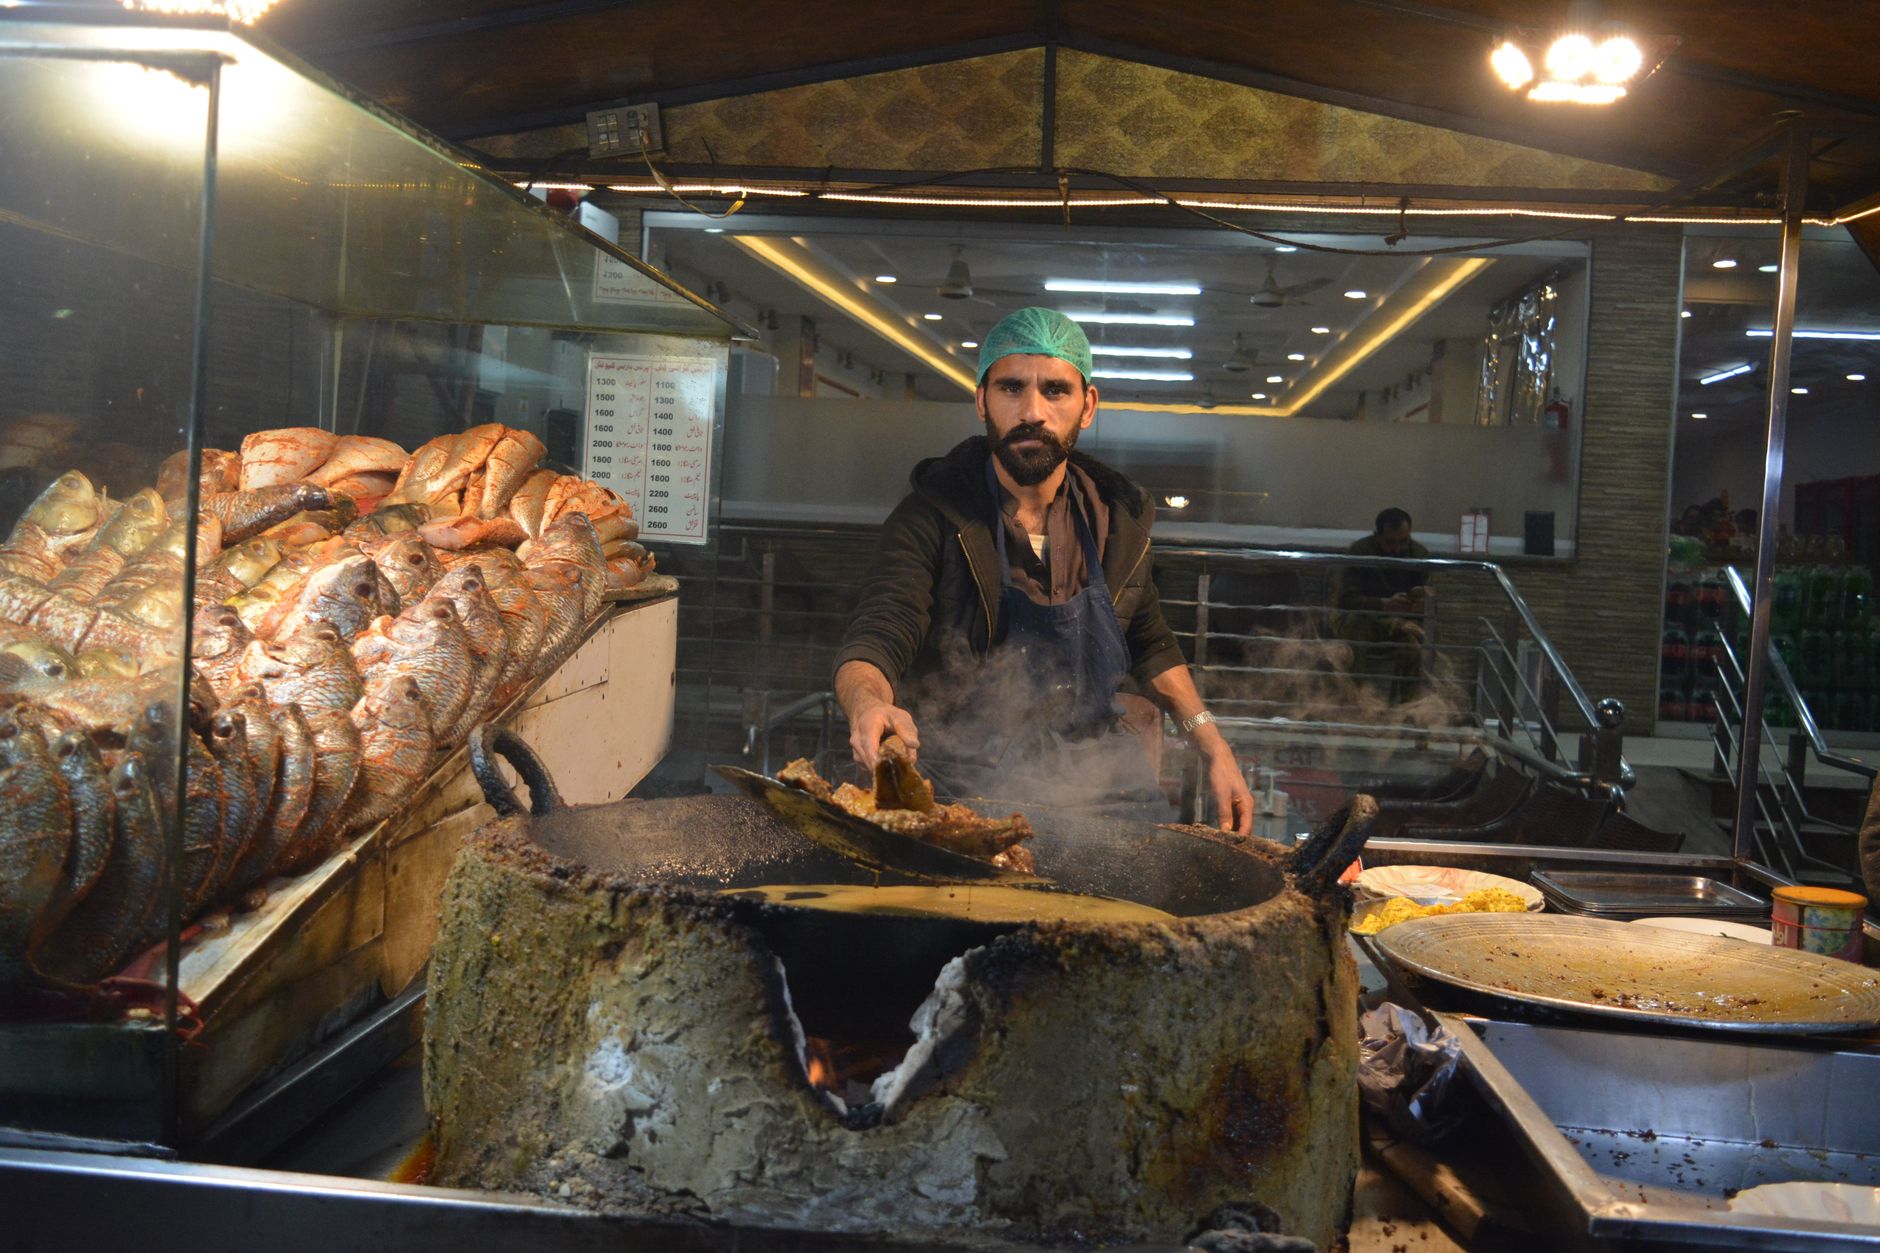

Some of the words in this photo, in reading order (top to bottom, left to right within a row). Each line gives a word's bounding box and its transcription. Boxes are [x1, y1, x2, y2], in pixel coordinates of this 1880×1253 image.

[596, 378, 616, 386] 1300
[655, 381, 675, 389] 1100
[594, 409, 614, 417] 1600
[654, 412, 673, 420] 1400
[653, 428, 672, 436] 1400
[593, 440, 613, 448] 2000
[651, 459, 671, 467] 1600
[591, 471, 611, 479] 2000
[649, 490, 669, 498] 2200
[648, 505, 668, 513] 2600
[648, 521, 667, 529] 2600
